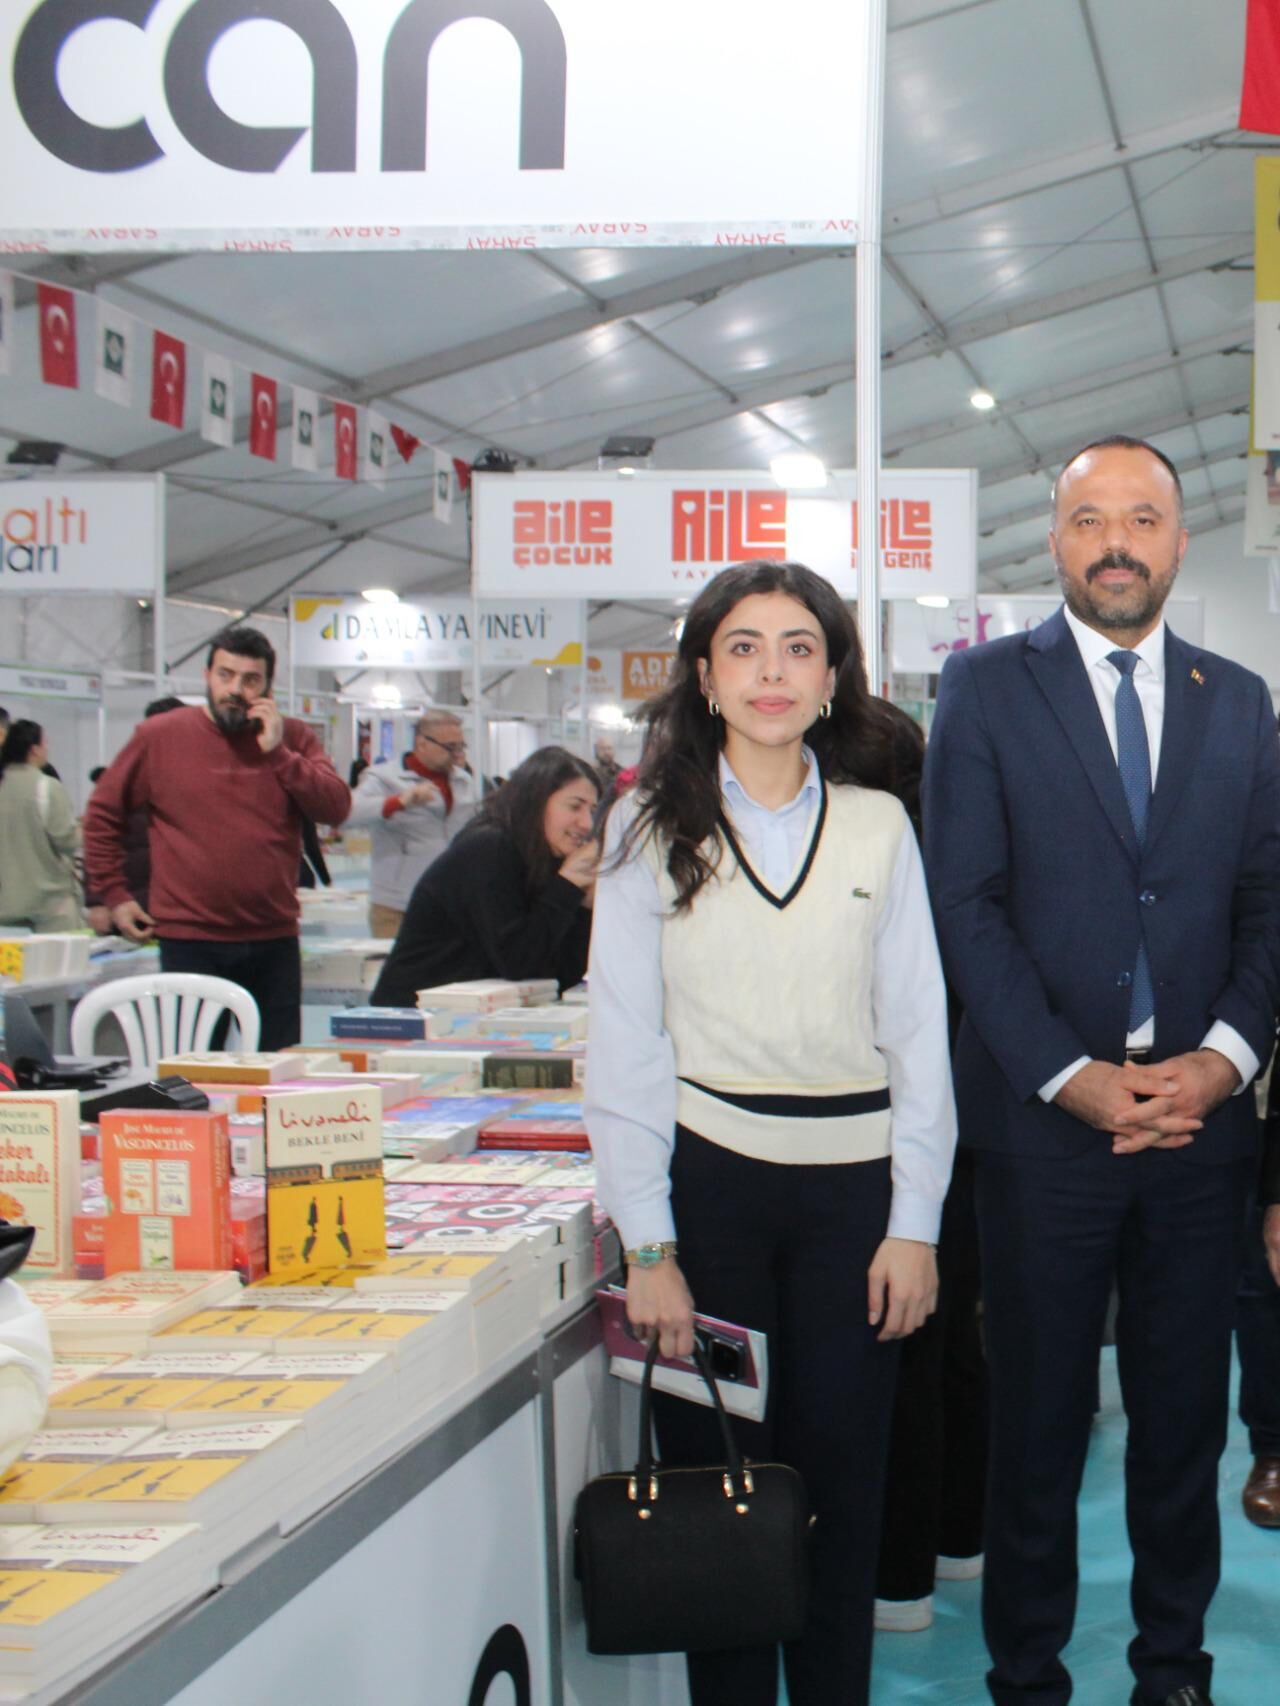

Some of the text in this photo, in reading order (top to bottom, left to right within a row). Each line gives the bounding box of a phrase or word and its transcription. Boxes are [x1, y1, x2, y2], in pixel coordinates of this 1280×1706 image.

[12, 0, 567, 174] can
[3, 496, 88, 545] altı
[287, 1136, 332, 1148] BEKLE
